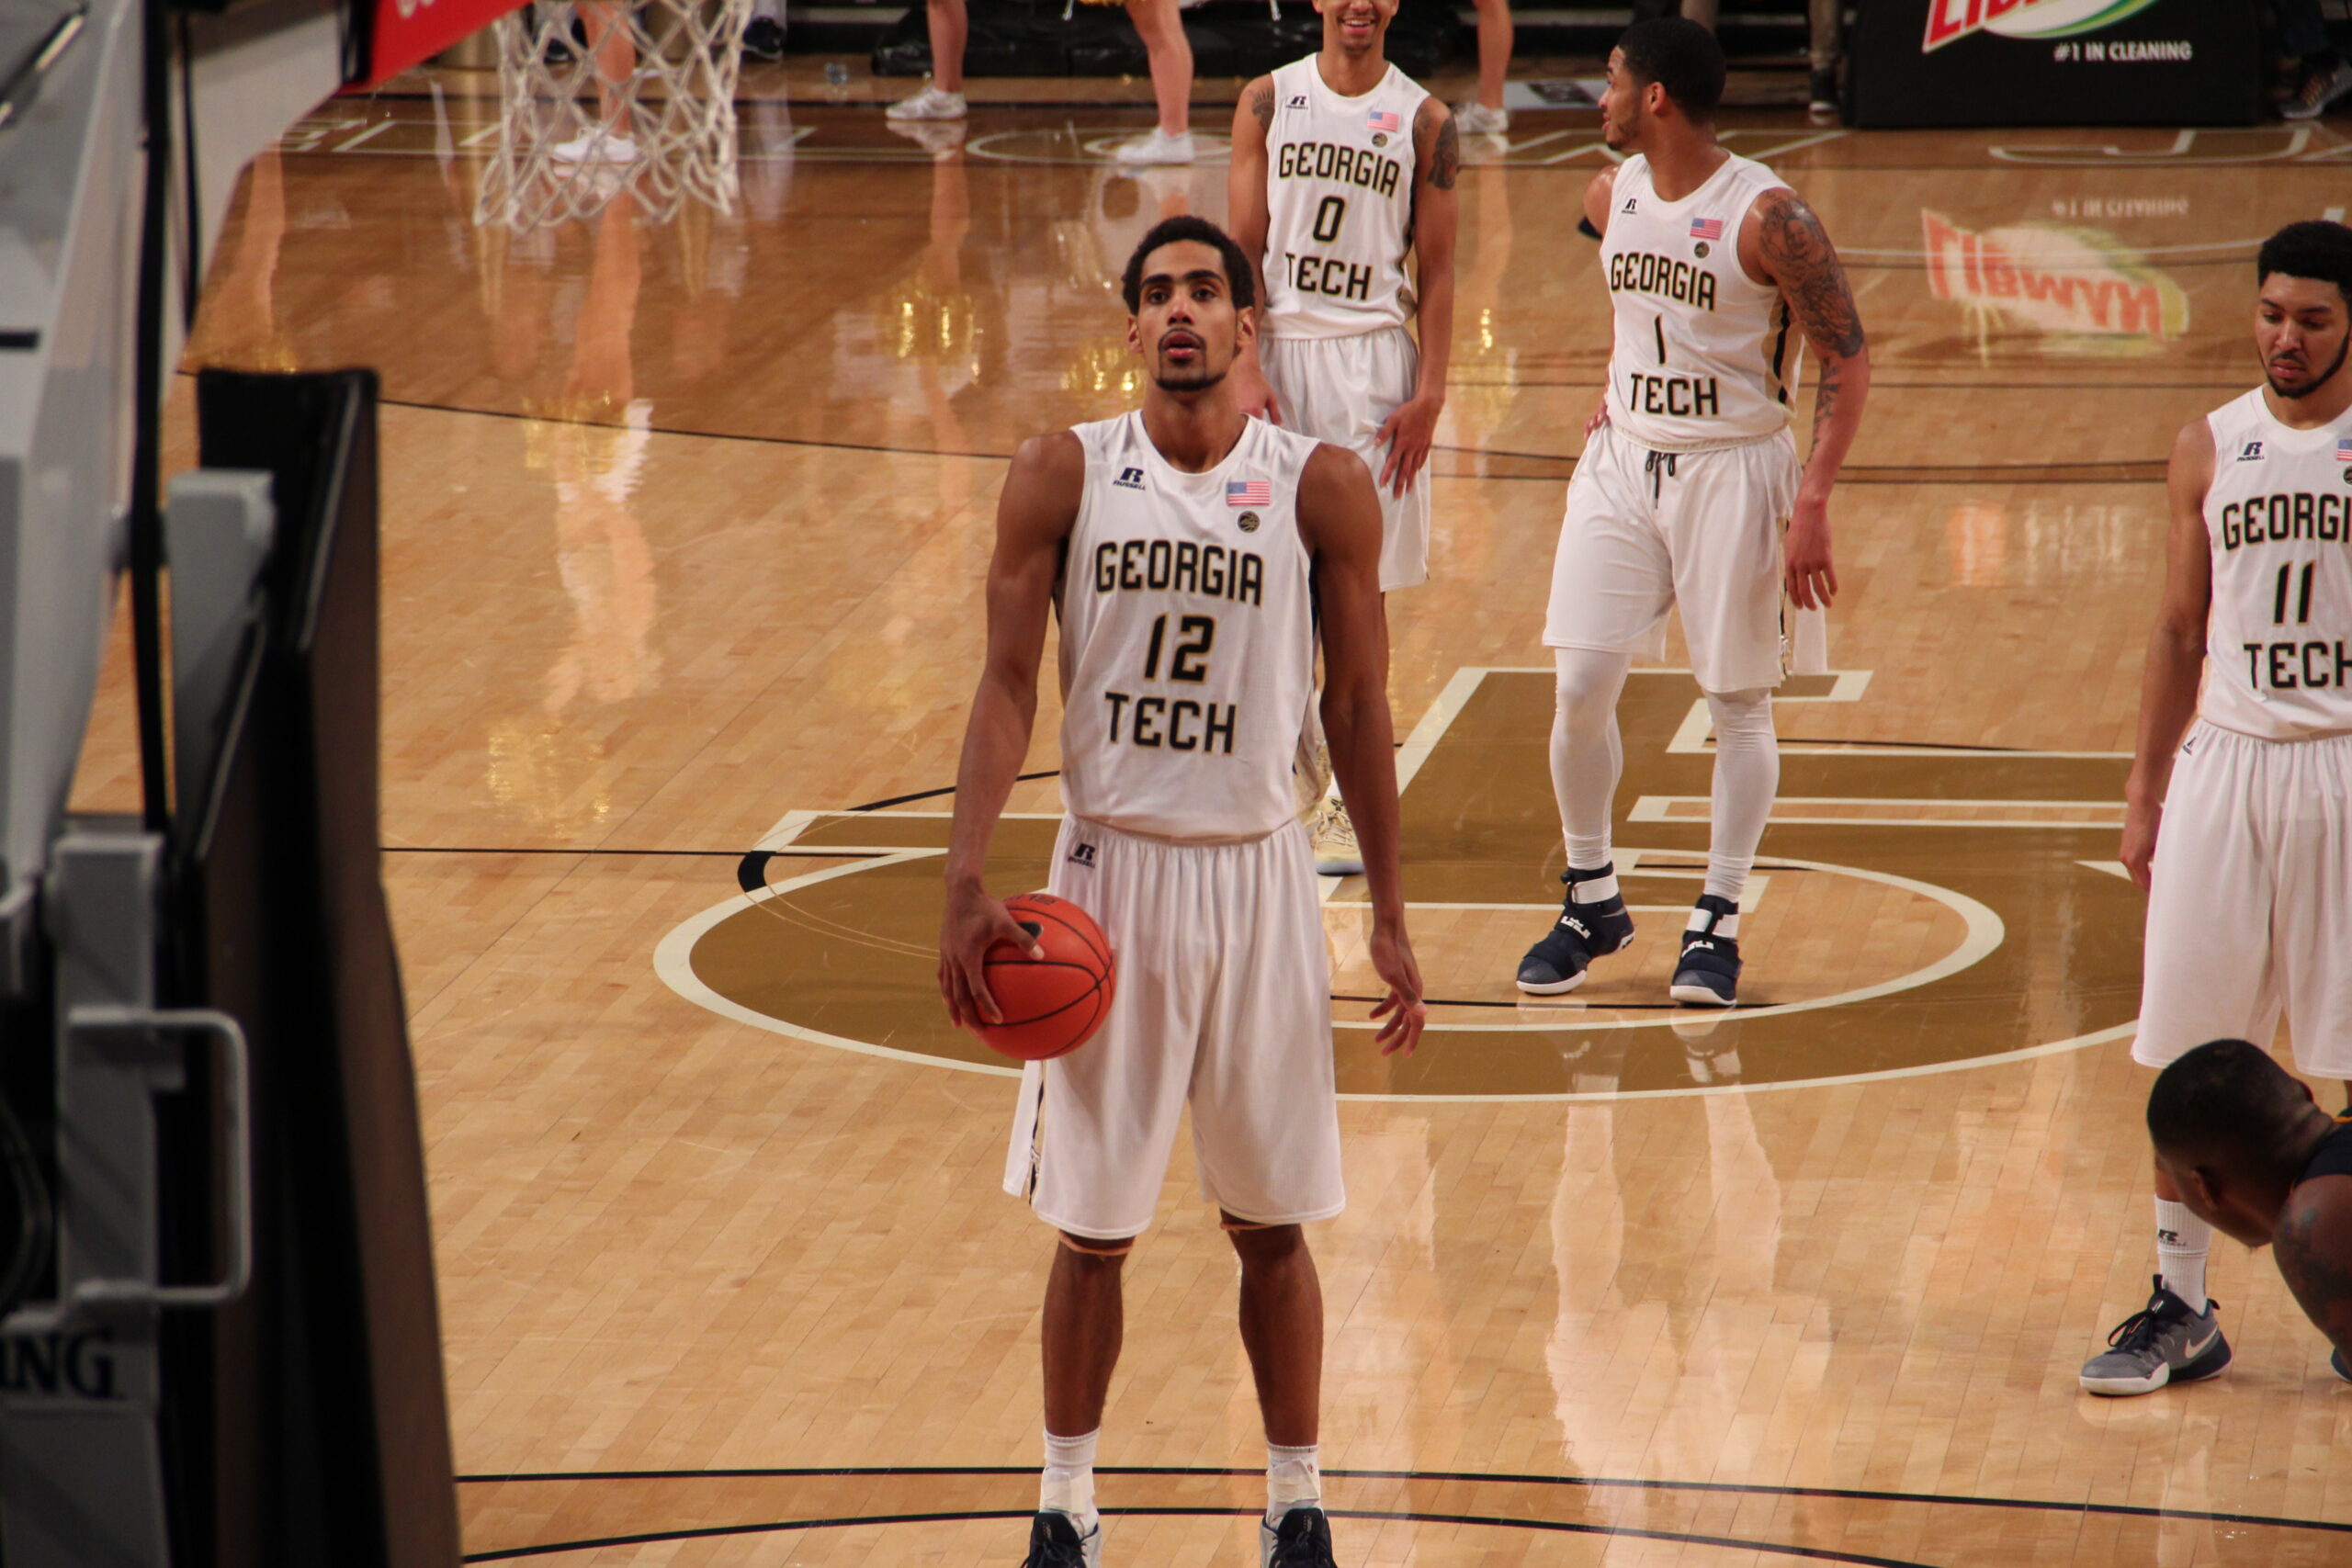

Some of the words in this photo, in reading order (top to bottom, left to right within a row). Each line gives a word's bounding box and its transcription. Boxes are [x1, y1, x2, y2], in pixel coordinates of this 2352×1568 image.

[2054, 41, 2080, 62] #1
[2085, 41, 2106, 62] IN
[2109, 40, 2193, 62] CLEANING
[1279, 142, 1400, 198] GEORGIA
[1312, 195, 1347, 243] 0
[1285, 252, 1372, 301] TECH
[1611, 252, 1716, 311] GEORGIA
[1654, 313, 1667, 365] 1
[1631, 373, 1719, 415] TECH
[1095, 539, 1263, 606] GEORGIA
[2273, 559, 2316, 626] 11
[1143, 612, 1216, 684] 12
[1104, 691, 1237, 755] TECH
